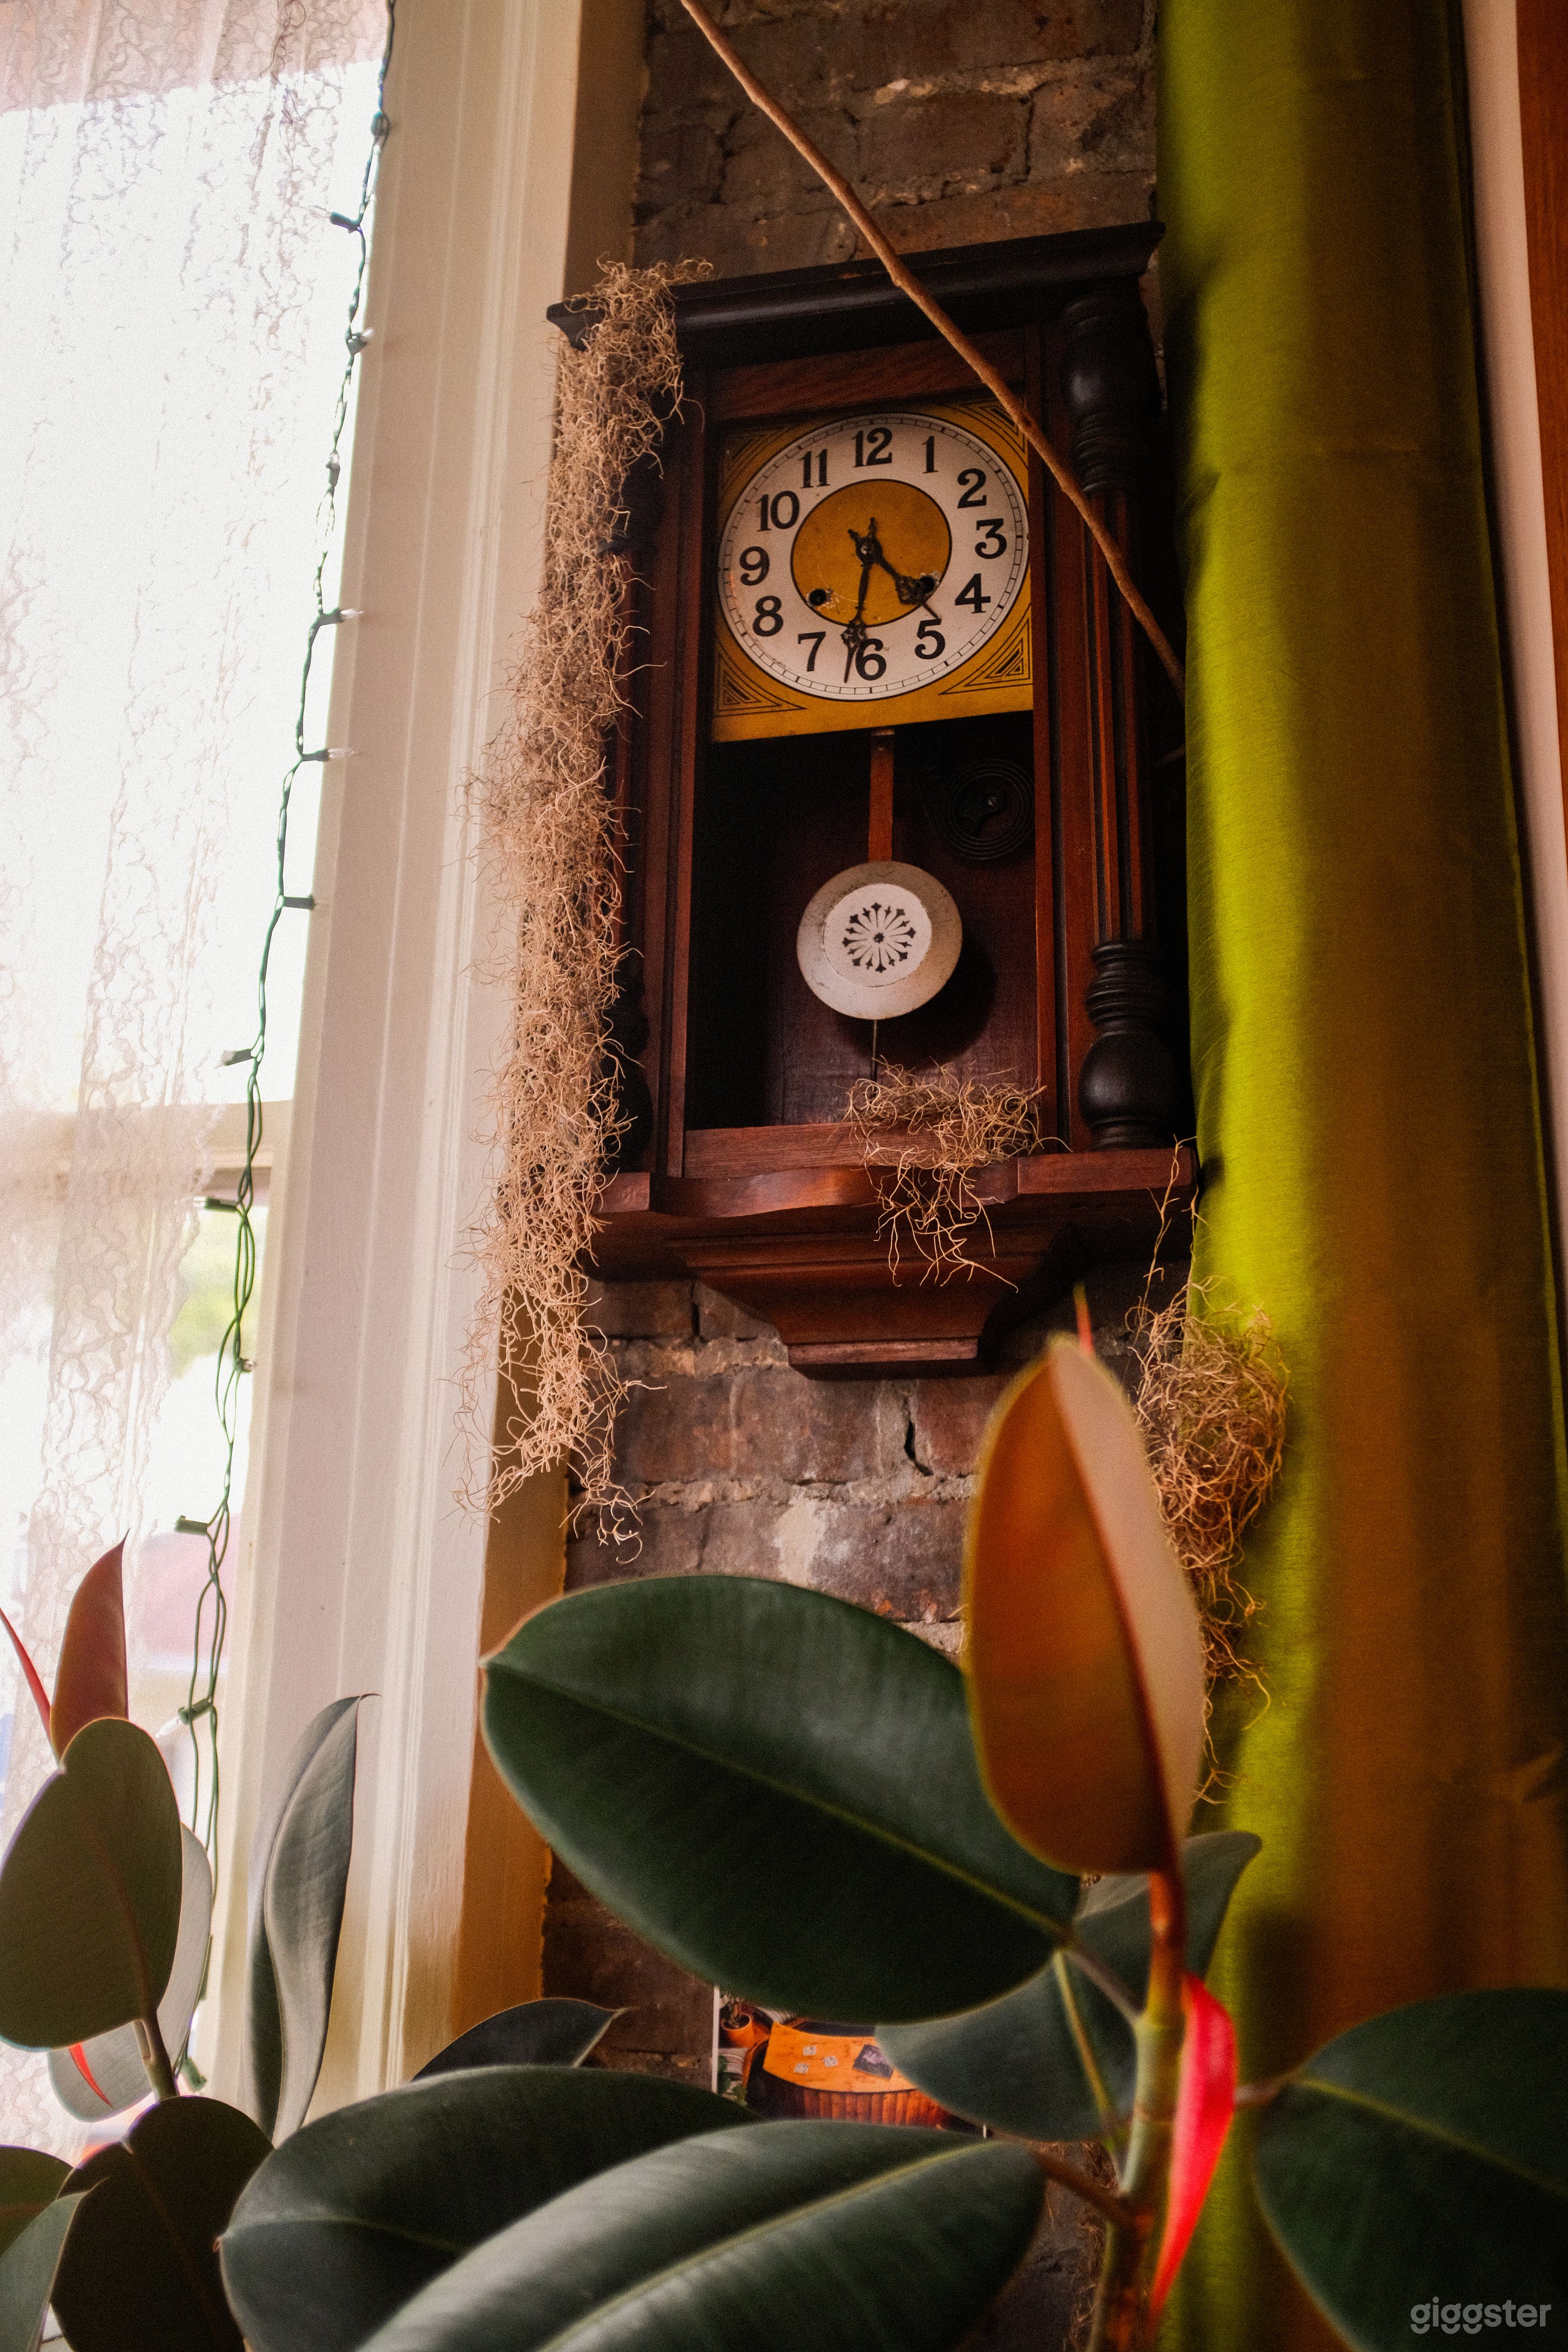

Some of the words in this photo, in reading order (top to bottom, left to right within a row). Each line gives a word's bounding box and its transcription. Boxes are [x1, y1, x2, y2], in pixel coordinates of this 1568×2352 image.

[852, 427, 892, 468] 12
[922, 436, 938, 473] 1
[800, 449, 829, 488] 11
[957, 468, 987, 509] 2
[755, 491, 800, 531] 10
[975, 518, 1007, 559] 3
[739, 546, 769, 585] 9
[954, 573, 991, 614] 4
[752, 596, 783, 637] 8
[797, 631, 826, 672] 7
[914, 618, 946, 659] 5
[855, 639, 886, 681] 6
